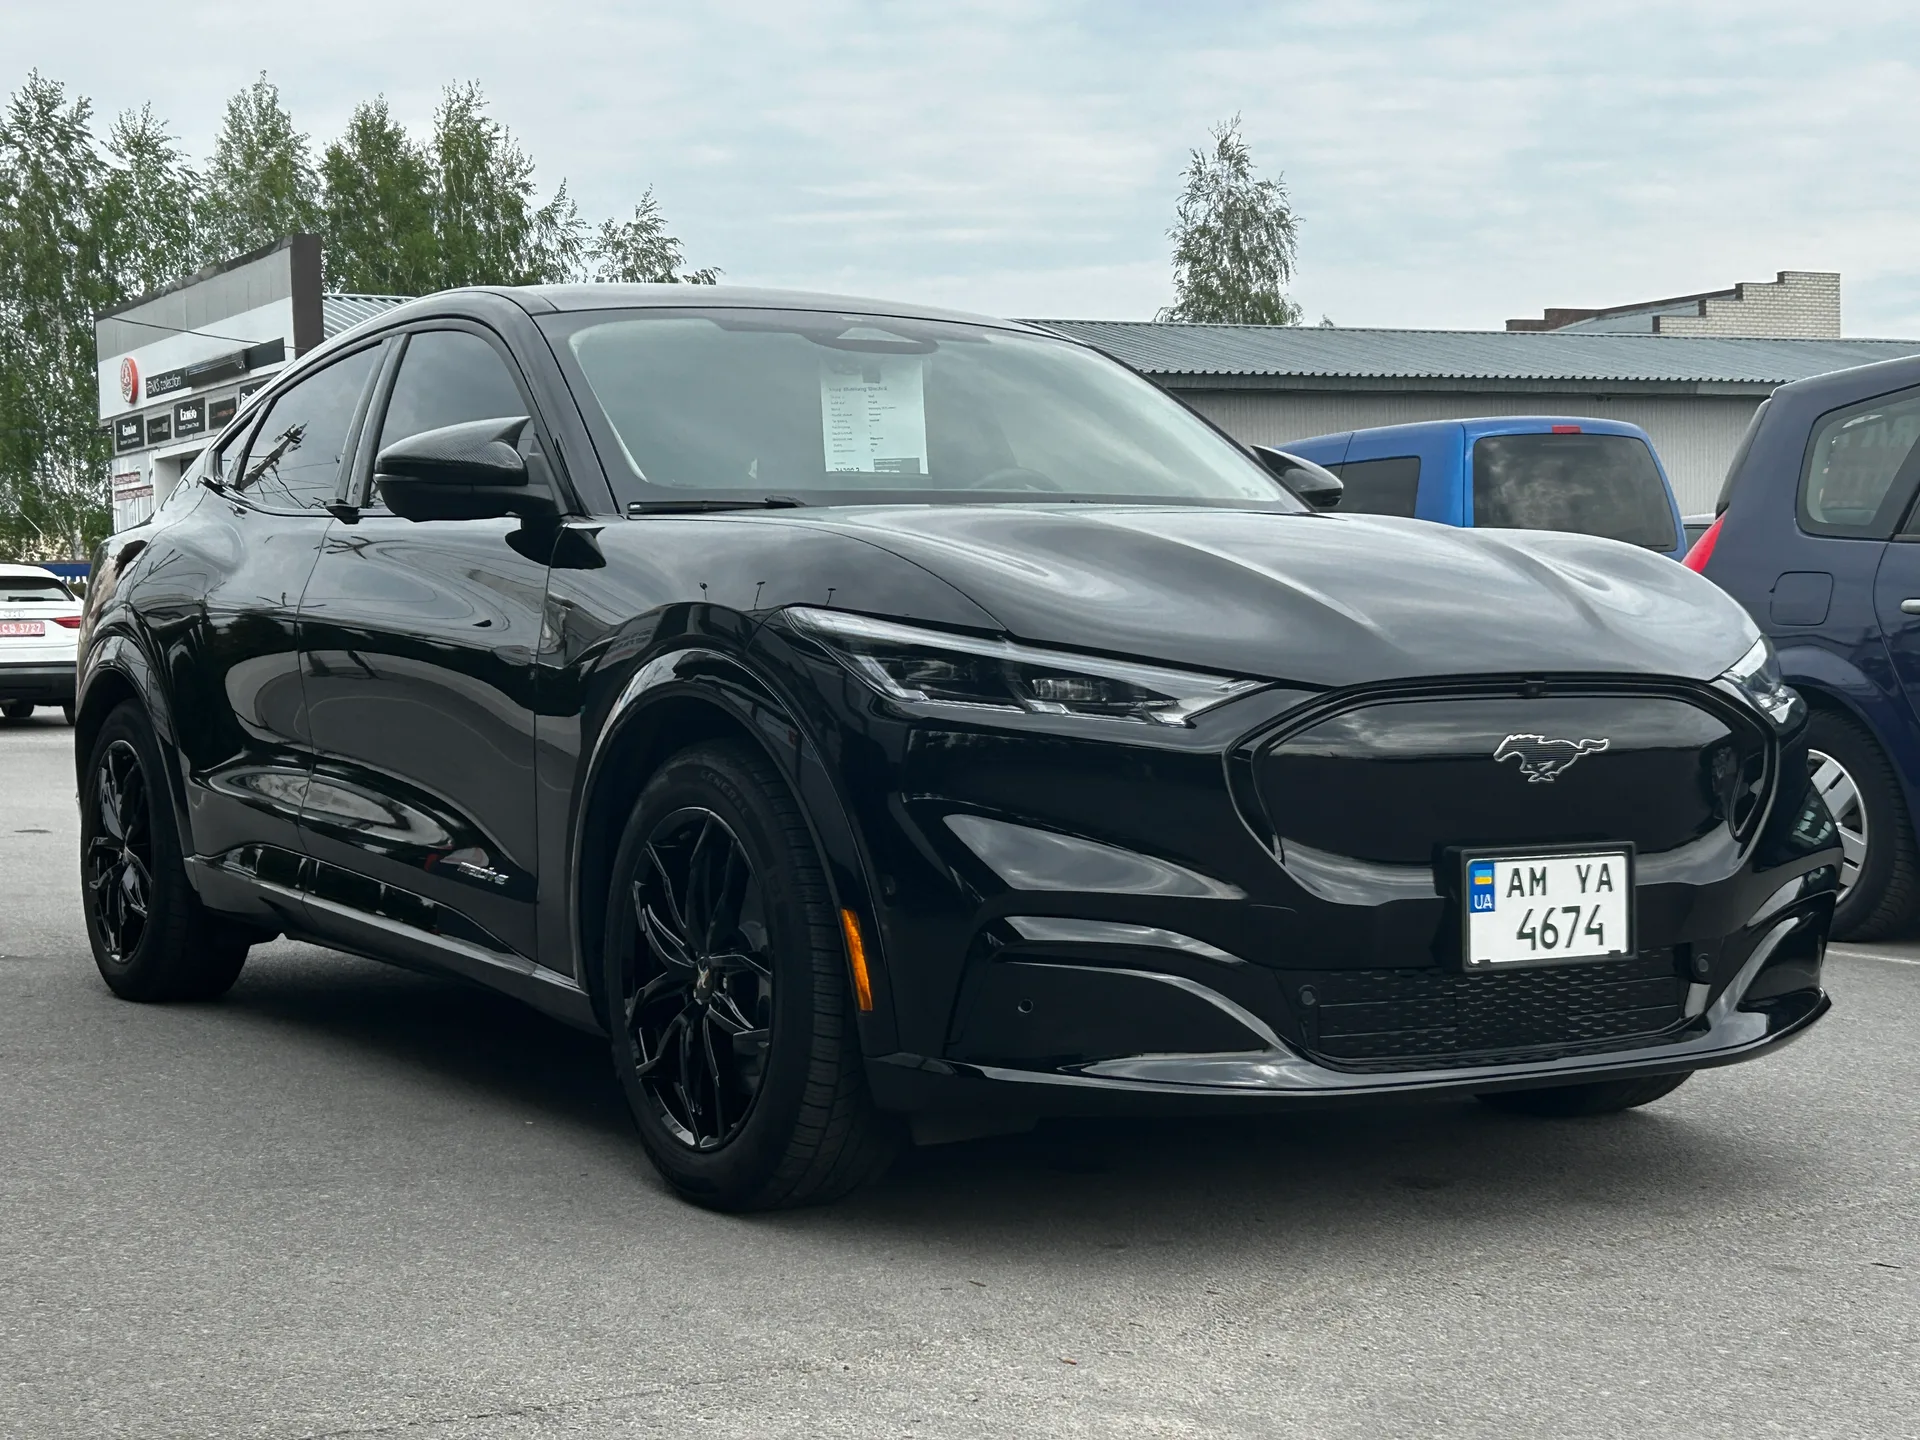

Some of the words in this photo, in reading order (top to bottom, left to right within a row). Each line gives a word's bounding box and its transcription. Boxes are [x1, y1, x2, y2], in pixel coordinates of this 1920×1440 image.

[1506, 866, 1547, 898] AM
[1575, 863, 1613, 894] YA
[1474, 894, 1493, 909] UA
[1516, 904, 1604, 951] 4674
